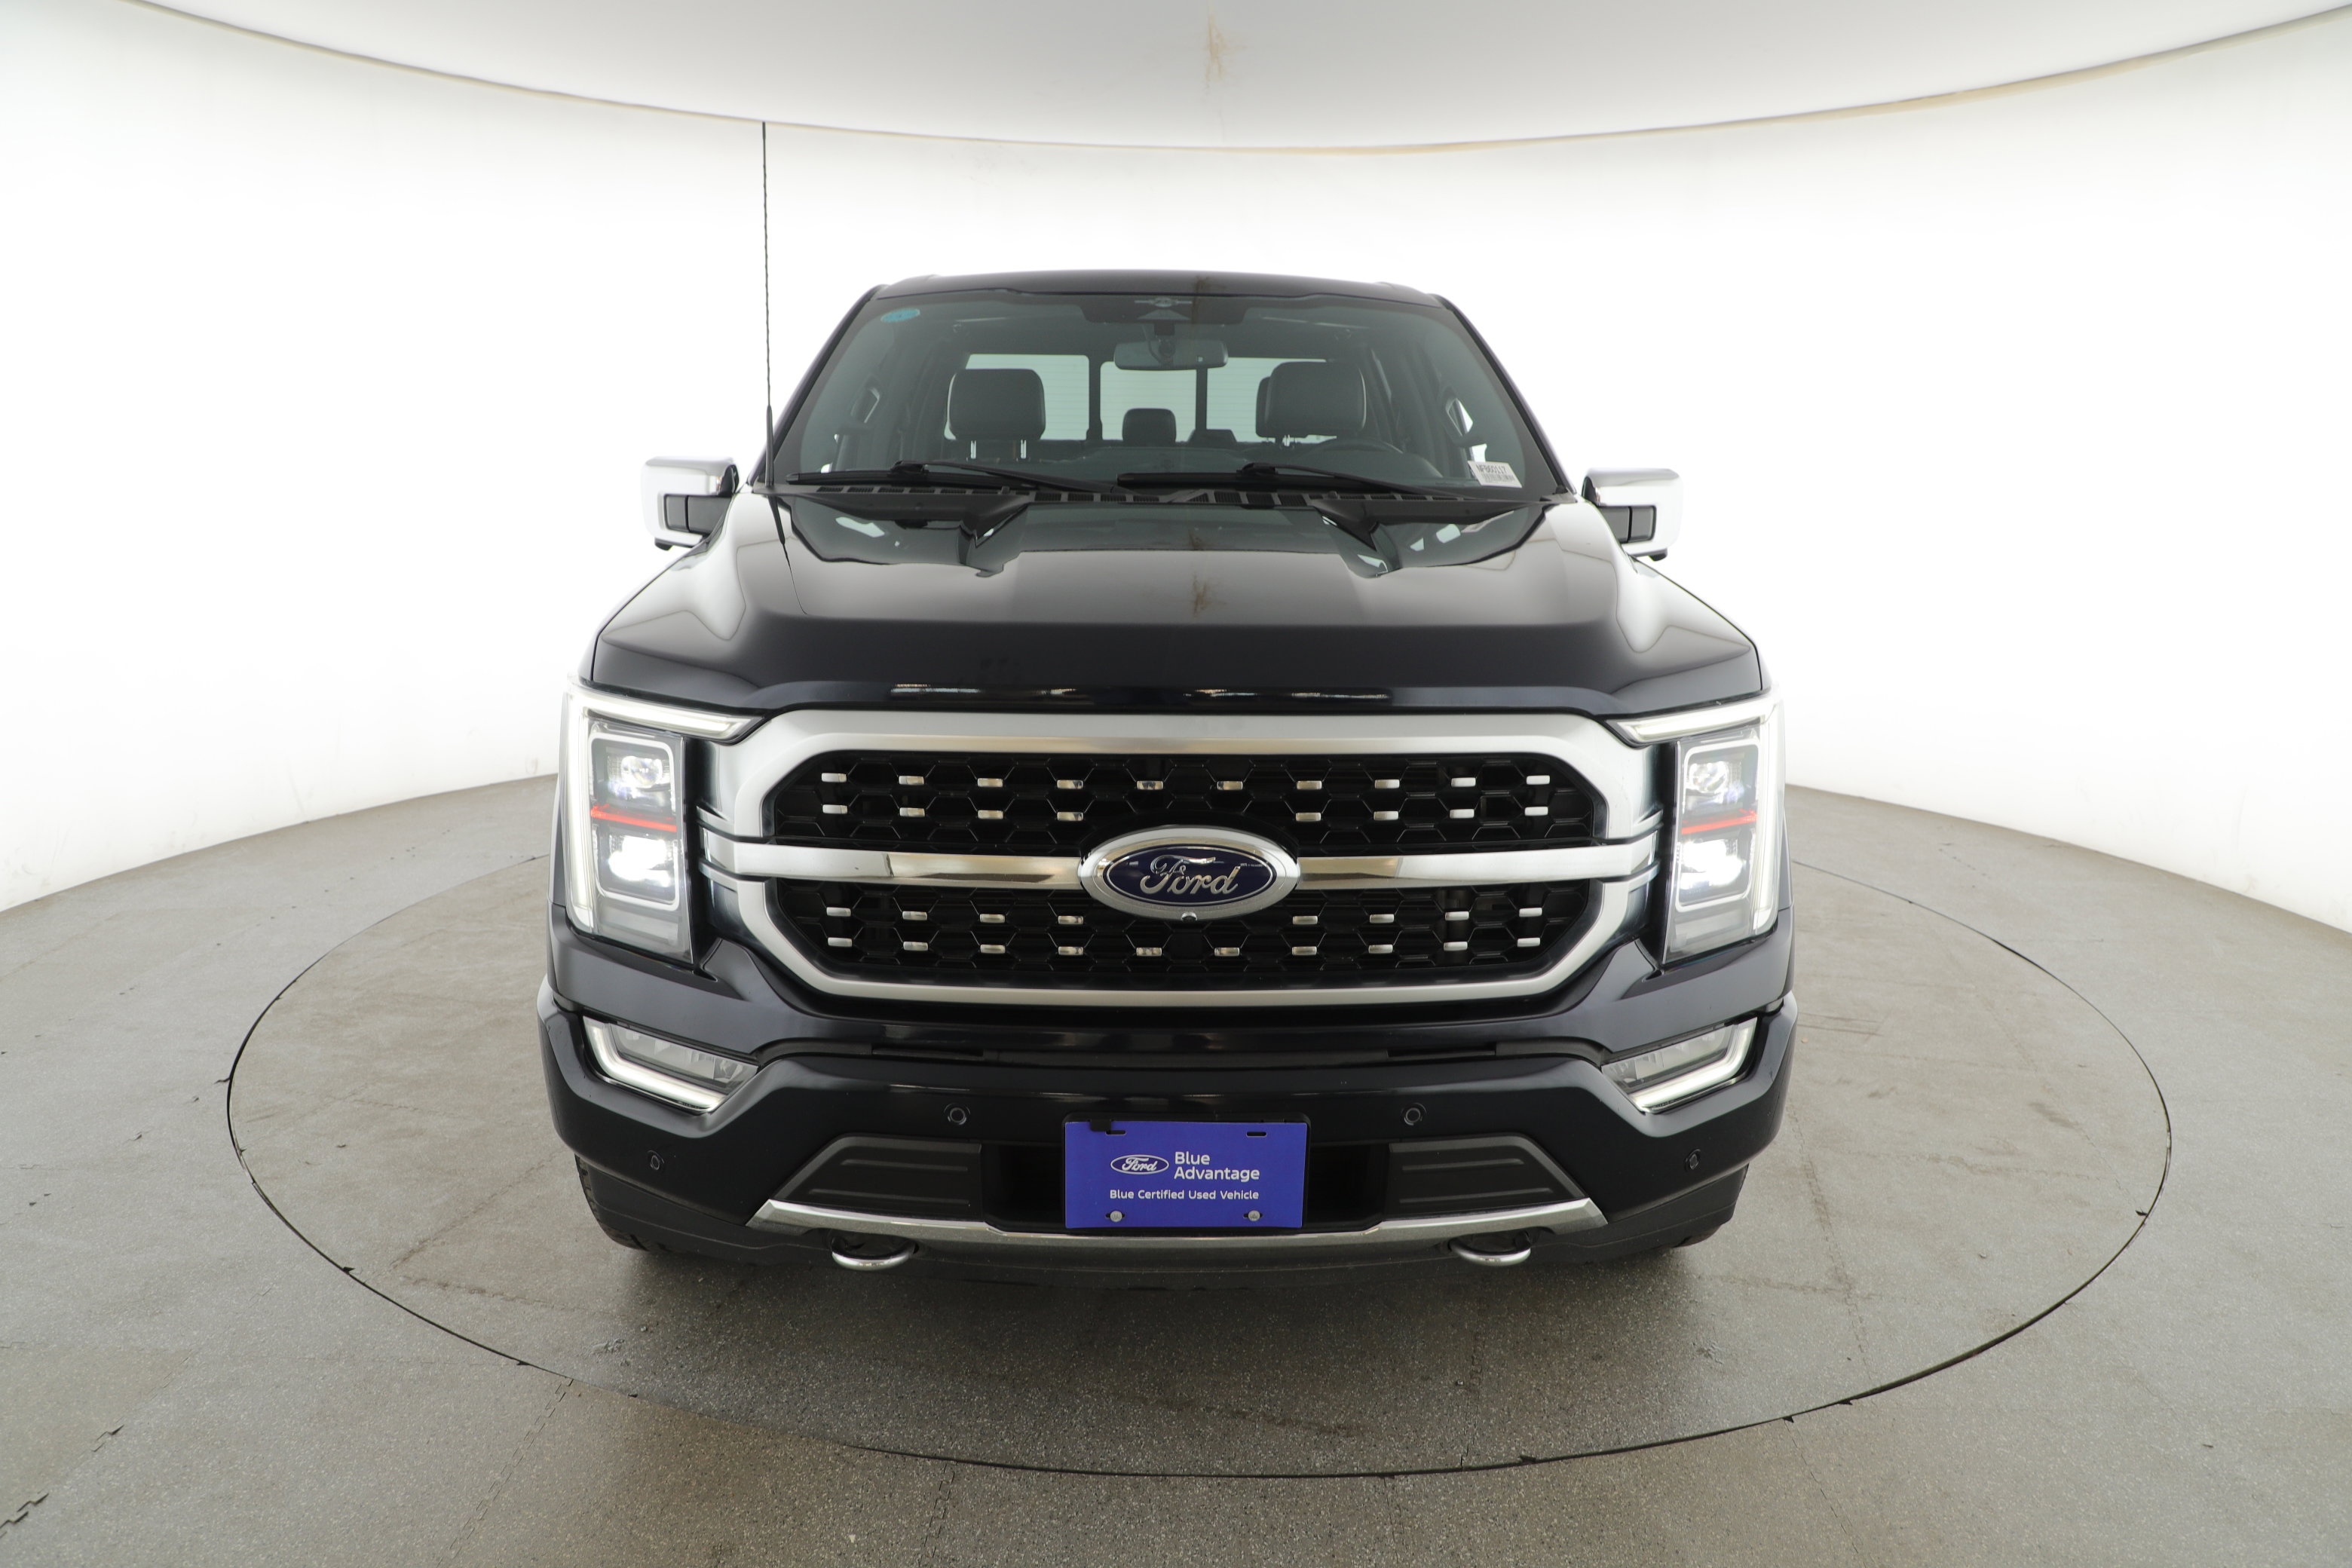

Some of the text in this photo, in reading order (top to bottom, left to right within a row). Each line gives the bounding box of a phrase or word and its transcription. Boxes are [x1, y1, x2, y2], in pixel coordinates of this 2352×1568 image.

[1140, 854, 1239, 895] Ford
[1121, 1157, 1158, 1172] Ford
[1174, 1151, 1211, 1165] Blue
[1174, 1167, 1260, 1182] Advantage
[1110, 1189, 1260, 1200] Blue Certified Used Vehicle
